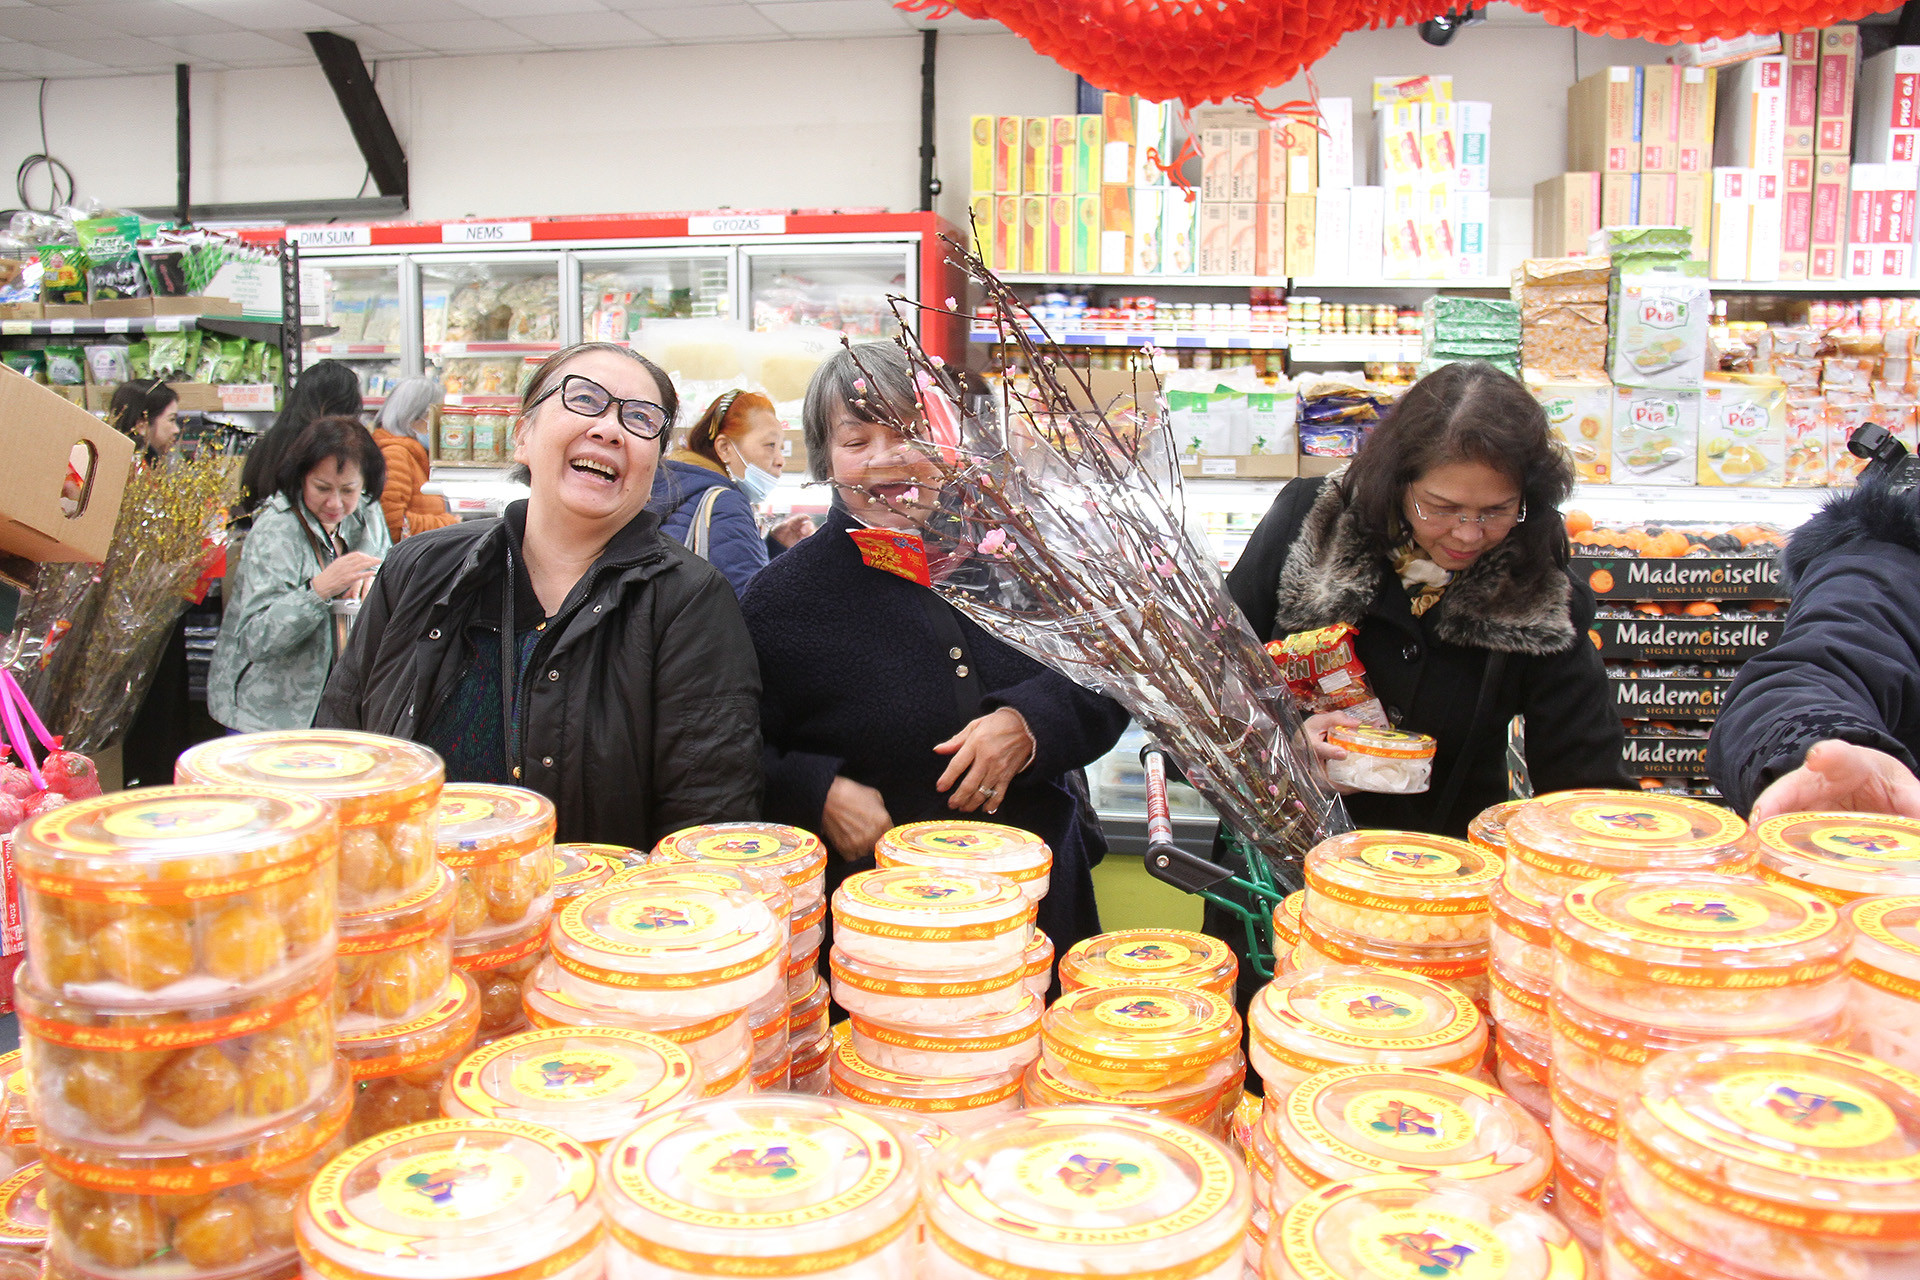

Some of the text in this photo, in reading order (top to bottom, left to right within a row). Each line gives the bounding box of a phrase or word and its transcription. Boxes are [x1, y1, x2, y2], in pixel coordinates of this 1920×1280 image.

[1833, 122, 1843, 148] VIFON
[1904, 135, 1914, 161] VIFON
[465, 225, 504, 240] NEMS
[712, 216, 760, 232] GYOZAS
[300, 229, 355, 245] DIM SUM
[1825, 250, 1834, 274] VIFON
[1863, 251, 1872, 275] VIFON
[1894, 251, 1903, 275] VIFON
[1628, 561, 1781, 585] Mademoiselle
[1656, 585, 1749, 595] SIGNE LA QUALITÉ
[1616, 623, 1770, 646] Mademoiselle
[1645, 647, 1737, 657] SIGNE LA QUALITÉ
[1641, 668, 1700, 678] Mademoiselle
[1645, 707, 1691, 715] SIGNE LA
[1523, 850, 1563, 872] Mừng
[1324, 886, 1358, 902] Chúc
[1361, 896, 1410, 913] Mừng
[1413, 901, 1459, 913] Năm
[564, 896, 591, 928] JOYEUSE
[570, 926, 587, 940] ET
[842, 914, 951, 941] Mừng Năm Mới
[586, 934, 651, 954] BONNE
[602, 974, 640, 987] Mới
[862, 979, 887, 992] Mới
[939, 985, 978, 996] Chúc
[978, 975, 1013, 992] Mừng
[1651, 962, 1839, 989] Chúc Mừng Năm
[1308, 995, 1477, 1048] BONNE ET JOYEUSE ANNEE
[469, 1026, 682, 1069] BONNE ET JOYEUSE ANNEE
[875, 1030, 909, 1046] Chúc
[914, 1038, 957, 1052] Mừng
[1002, 1031, 1027, 1045] Mới
[1060, 1046, 1093, 1066] Năm
[1098, 1059, 1129, 1071] Mới
[1327, 1064, 1391, 1081] ANNEE
[850, 1086, 1000, 1110] Năm Mới Chúc
[1293, 1075, 1329, 1117] JOYEUSE
[1297, 1116, 1314, 1133] ET
[1163, 1129, 1218, 1165] BONNE
[1311, 1132, 1381, 1169] BONNE
[316, 1155, 354, 1203] BONNE
[355, 1142, 375, 1159] ET
[376, 1119, 474, 1146] JOYEUSE
[480, 1120, 556, 1141] ANNEE
[621, 1167, 892, 1227] BONNE ET JOYEUSE ANNEE
[1158, 1179, 1230, 1234] JOYEUSE
[1055, 1227, 1149, 1242] ANNEE
[1287, 1202, 1319, 1247] ANNEE
